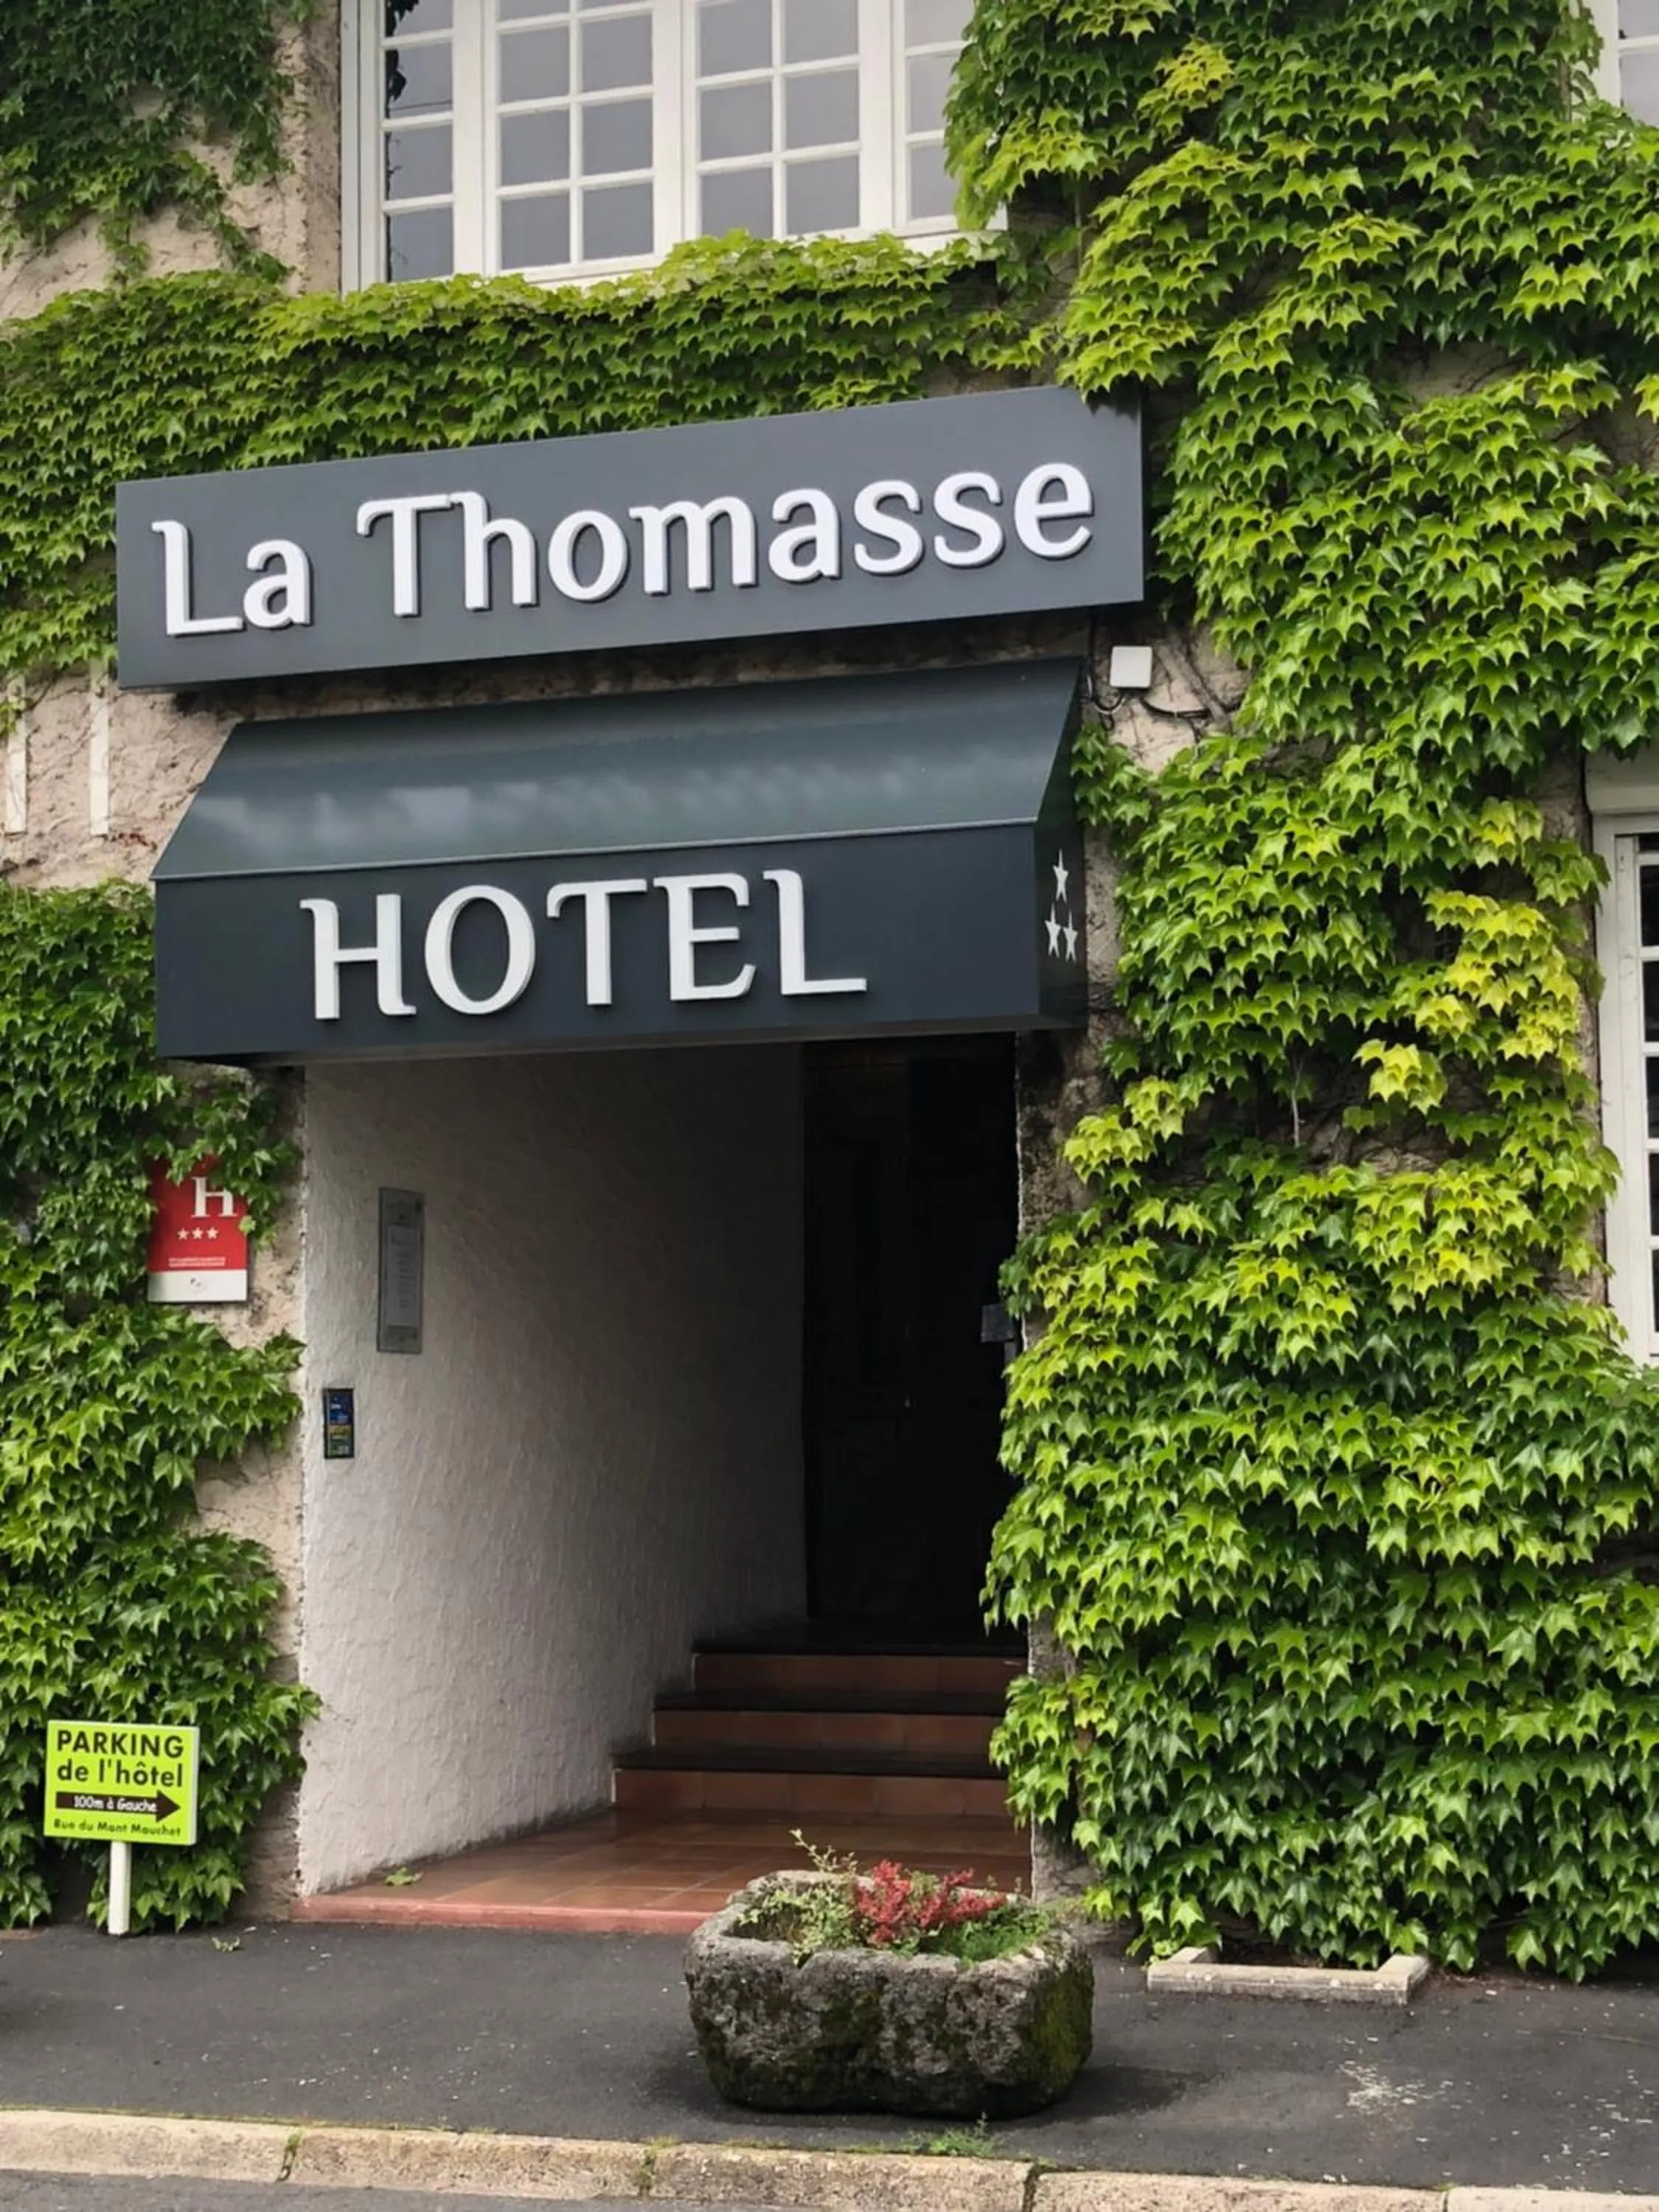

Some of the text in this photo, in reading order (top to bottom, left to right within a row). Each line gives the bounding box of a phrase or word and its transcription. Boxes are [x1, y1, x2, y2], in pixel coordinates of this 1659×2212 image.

[152, 462, 1095, 638] La Thomasse
[299, 869, 869, 1020] HOTEL
[190, 1175, 238, 1218] H
[57, 1729, 184, 1759] PARKING
[57, 1758, 182, 1787] de l'hôtel
[74, 1795, 157, 1812] 100m à Gauche
[54, 1818, 75, 1829] Rue
[78, 1820, 94, 1831] du
[97, 1820, 127, 1832] Mont
